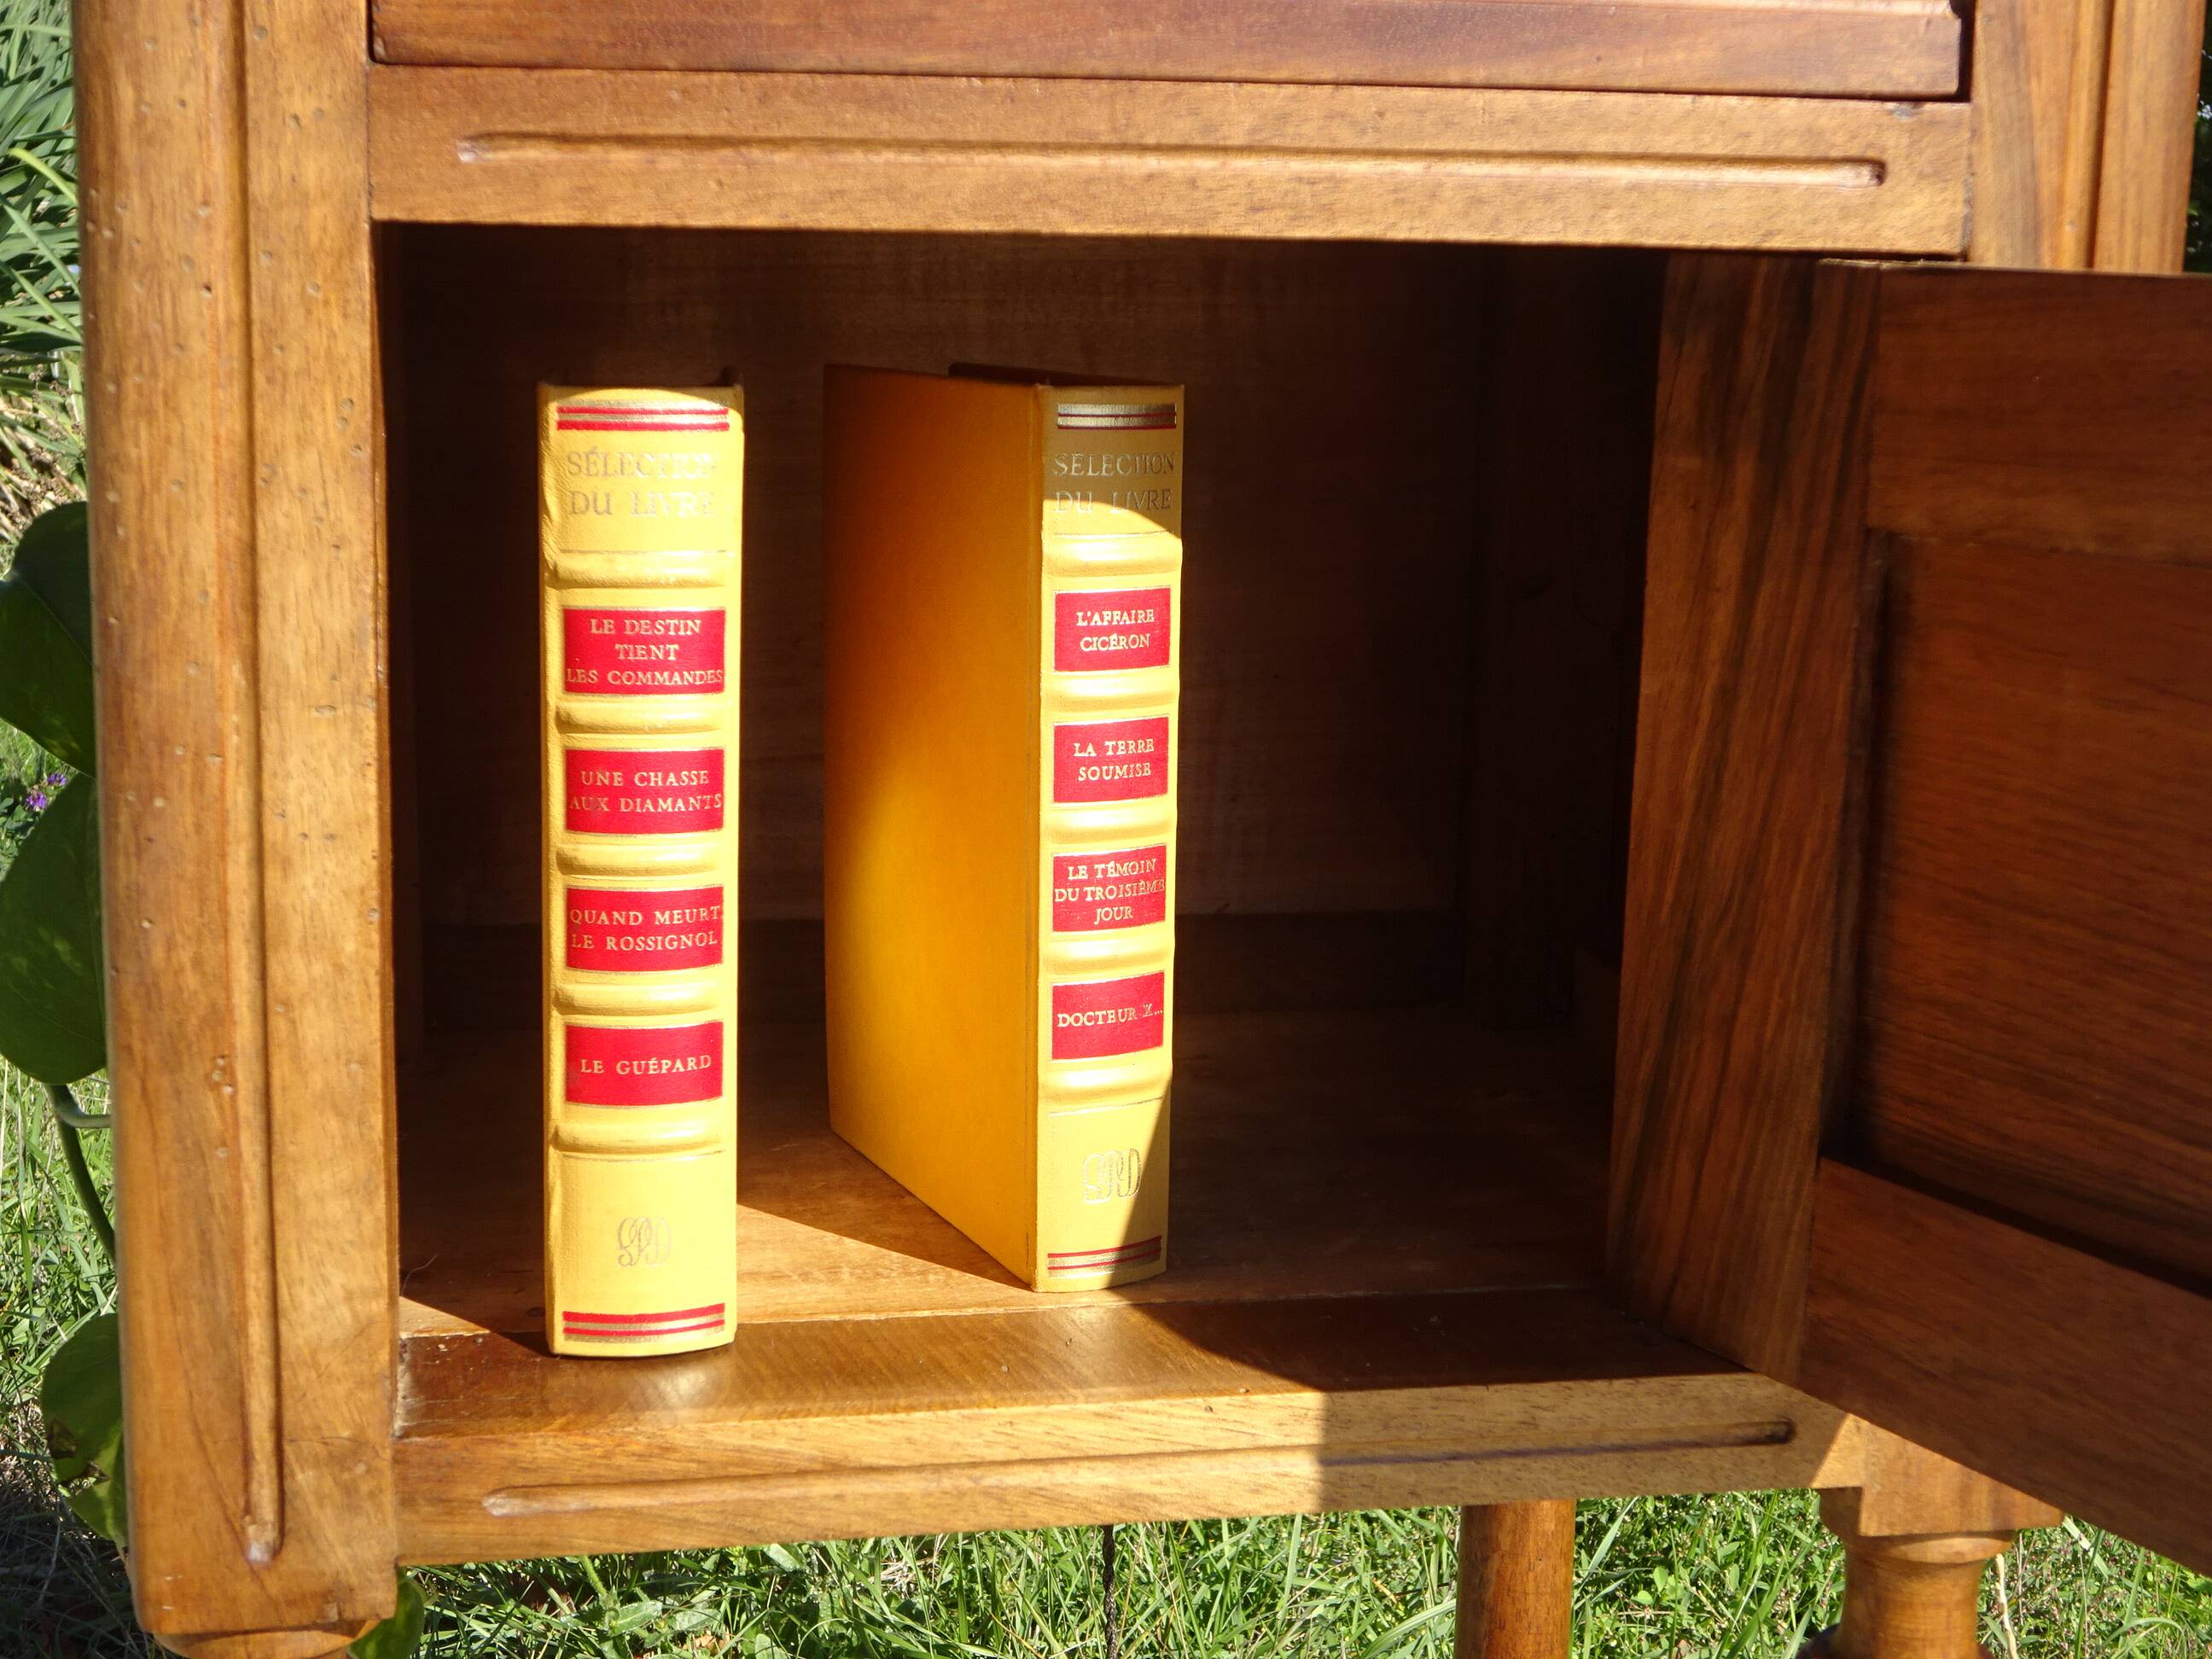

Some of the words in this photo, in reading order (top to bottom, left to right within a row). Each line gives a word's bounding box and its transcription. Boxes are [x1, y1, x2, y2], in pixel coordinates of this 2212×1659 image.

[1053, 451, 1175, 476] SÉLECTION
[569, 490, 613, 515] DU
[630, 490, 717, 519] LIVRE
[1054, 490, 1093, 515] DU
[1109, 489, 1173, 515] LIVRE
[1076, 608, 1155, 626] L'AFFAIRE
[591, 619, 614, 634] LE
[625, 619, 701, 636] DESTIN
[614, 643, 679, 661] TIENT
[1080, 633, 1150, 652] CICÉRON
[567, 668, 597, 684] LES
[607, 669, 724, 685] COMMANDES
[1074, 742, 1097, 757] LA
[1104, 738, 1155, 756] TERRE
[581, 771, 624, 787] UNE
[634, 770, 709, 787] CHASSE
[1078, 762, 1151, 782] SOUMISE
[570, 795, 610, 812] AUX
[620, 793, 723, 812] DIAMANTS
[1068, 865, 1089, 880] LE
[1093, 859, 1156, 879] TÉMOIN
[1055, 888, 1080, 902] DU
[1083, 879, 1166, 901] TROISIÈME
[570, 910, 643, 926] QUAND
[655, 905, 720, 925] MEURT
[1093, 905, 1133, 925] JOUR
[571, 934, 594, 949] LE
[606, 930, 718, 951] ROSSIGNOL
[1057, 1007, 1138, 1027] DOCTEUR
[580, 1059, 604, 1074] LE
[615, 1054, 712, 1075] GUÉPARD
